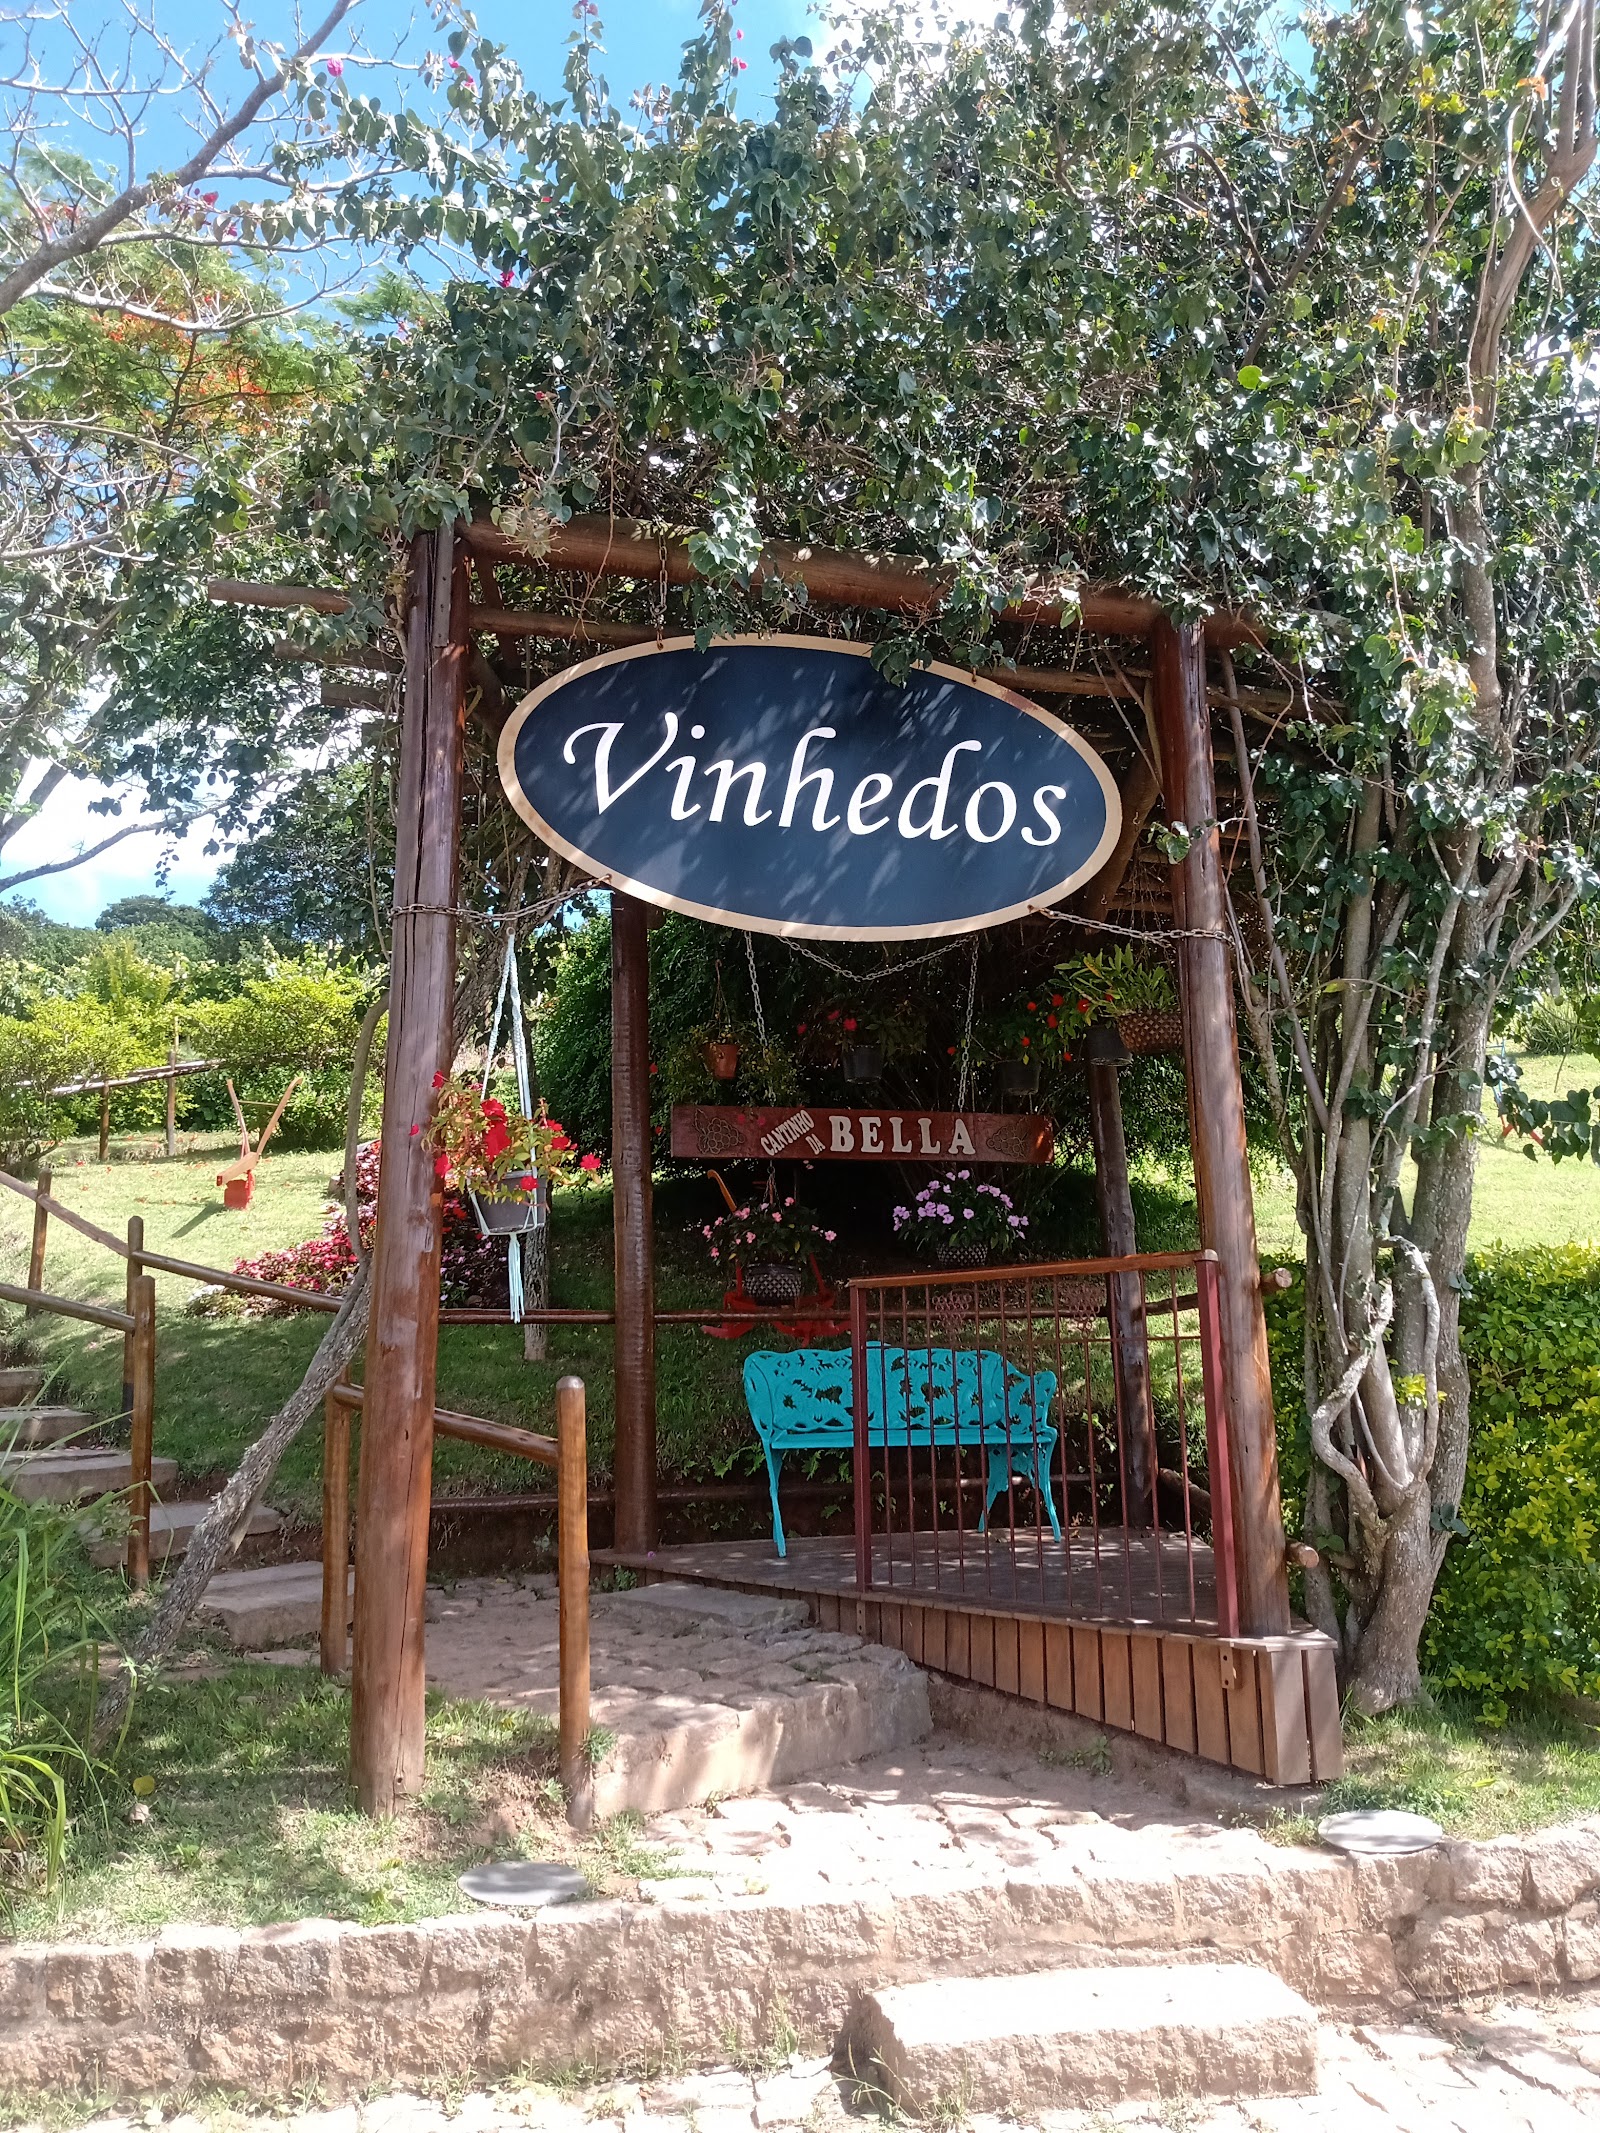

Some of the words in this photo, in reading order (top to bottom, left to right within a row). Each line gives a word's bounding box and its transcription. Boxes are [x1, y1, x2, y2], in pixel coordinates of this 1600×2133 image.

[563, 711, 1068, 847] Vinhedos
[760, 1109, 815, 1156] CANTINHO
[805, 1134, 826, 1155] DA
[829, 1115, 976, 1154] BELLA
